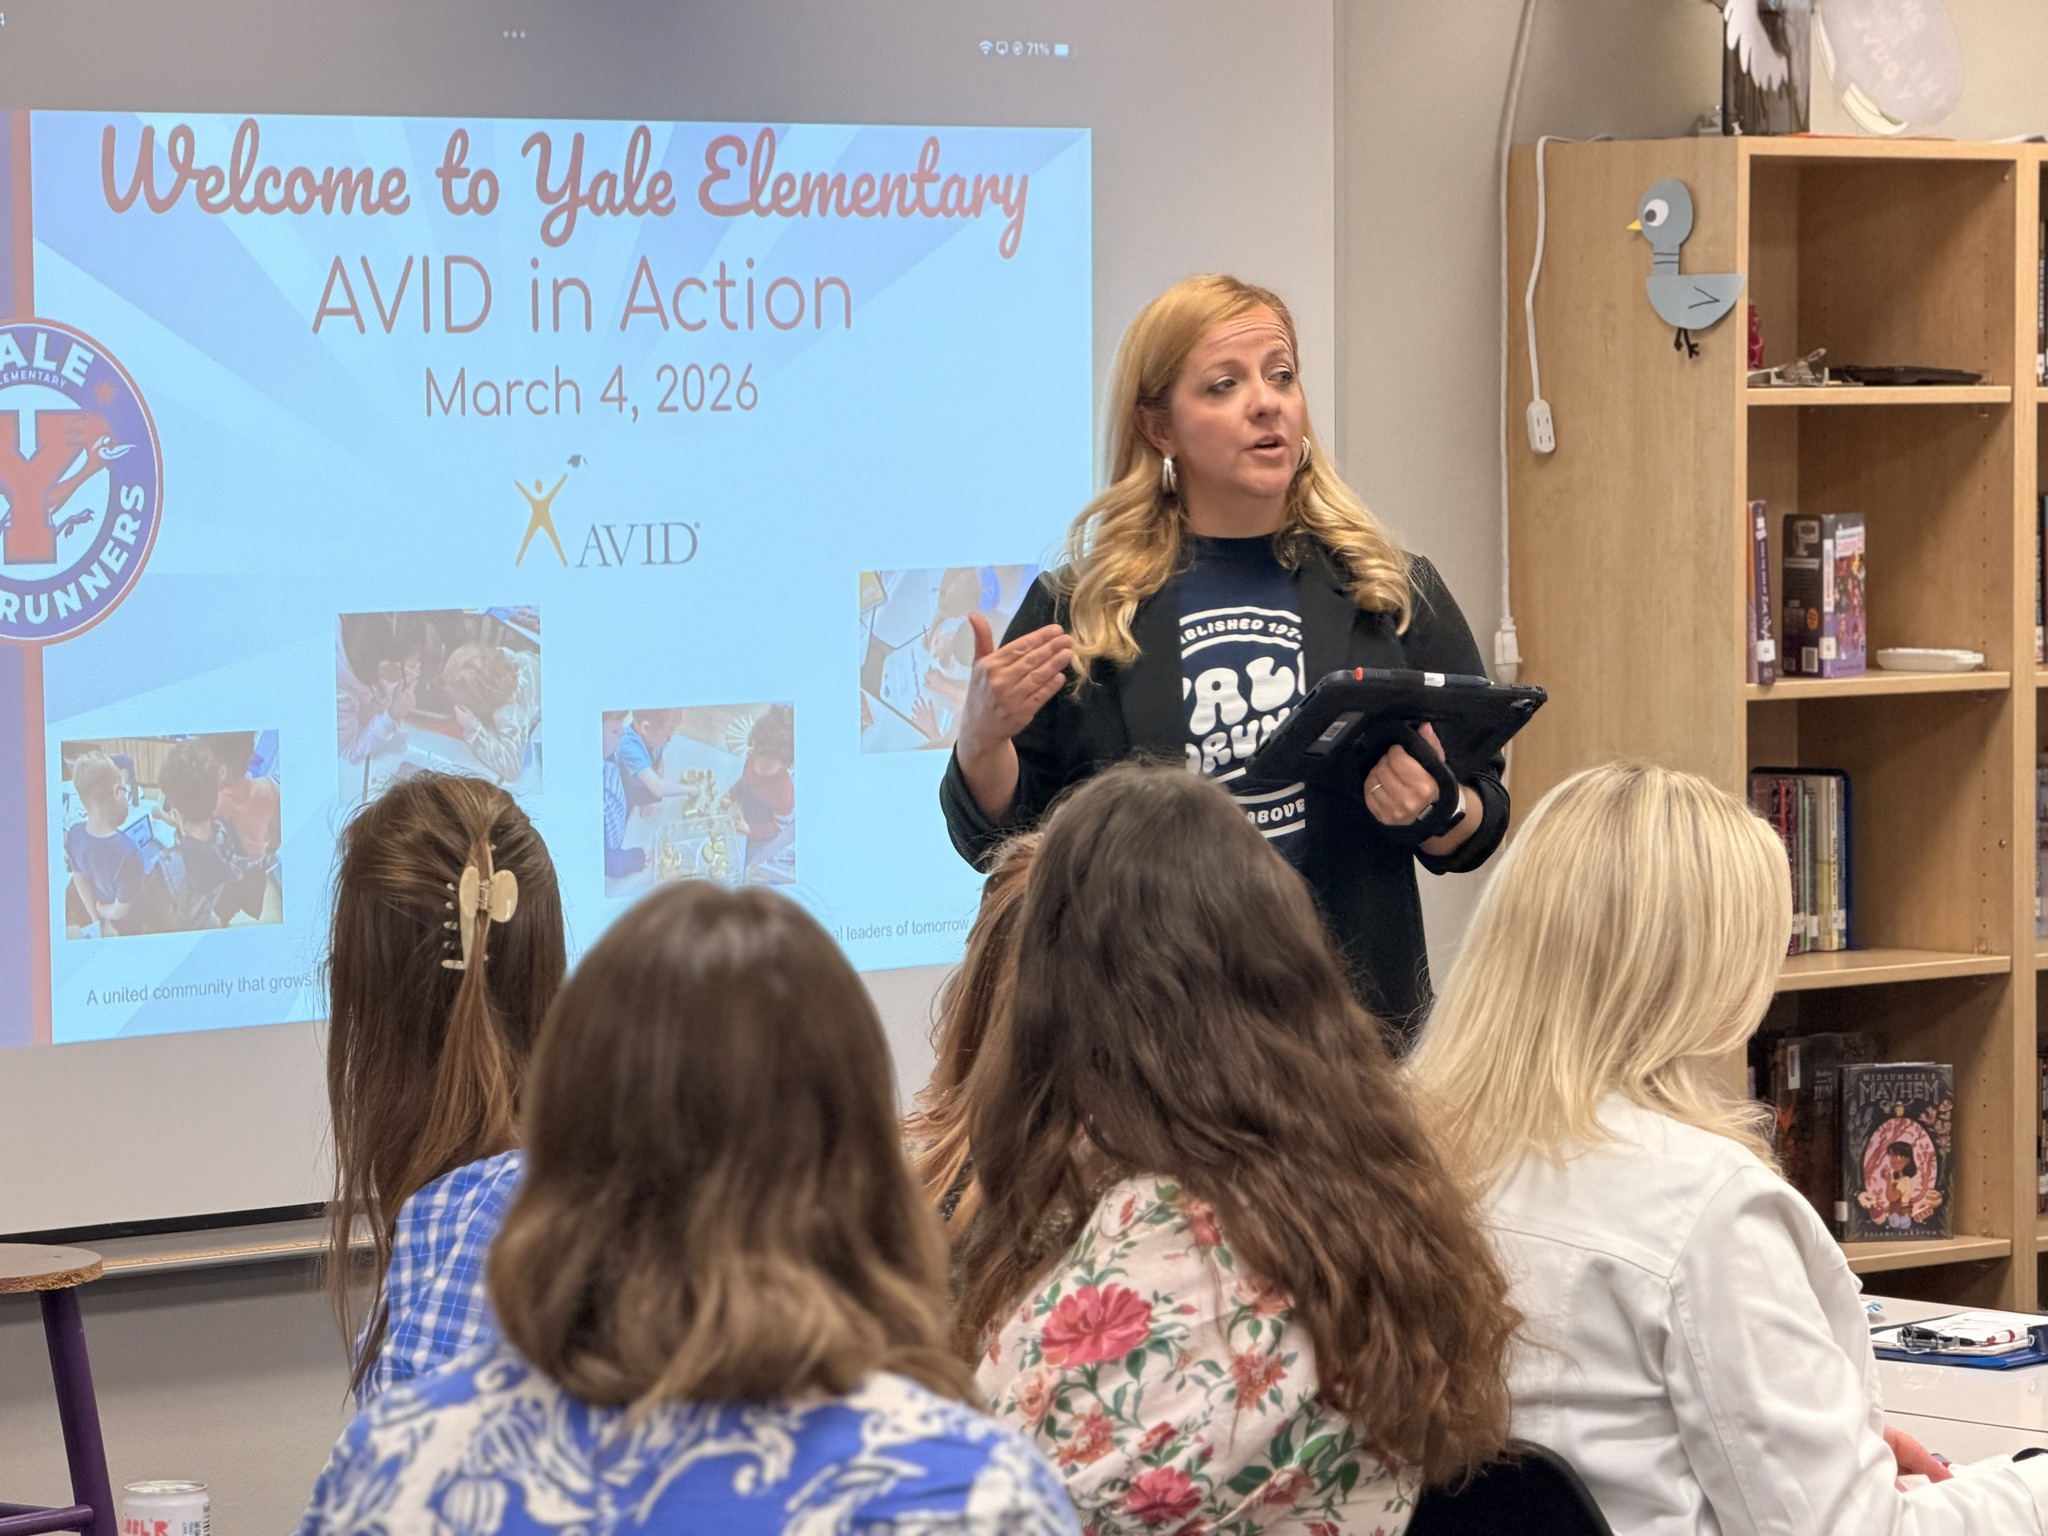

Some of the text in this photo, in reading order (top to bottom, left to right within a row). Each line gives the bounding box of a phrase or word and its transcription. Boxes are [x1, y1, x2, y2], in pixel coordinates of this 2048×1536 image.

[1027, 42, 1050, 56] 71%
[101, 118, 1028, 260] Welcome to Yale Elementary
[312, 255, 852, 334] AVID in Action
[0, 370, 67, 388] EMENTARY
[425, 363, 758, 423] March 4, 2026
[574, 521, 699, 568] AVID
[1246, 798, 1305, 824] ABOVE
[847, 924, 893, 941] leaders
[896, 920, 909, 936] of
[911, 919, 970, 935] tomorrow
[86, 972, 312, 1006] A united community that grows
[1859, 1080, 1939, 1106] MAYHEM
